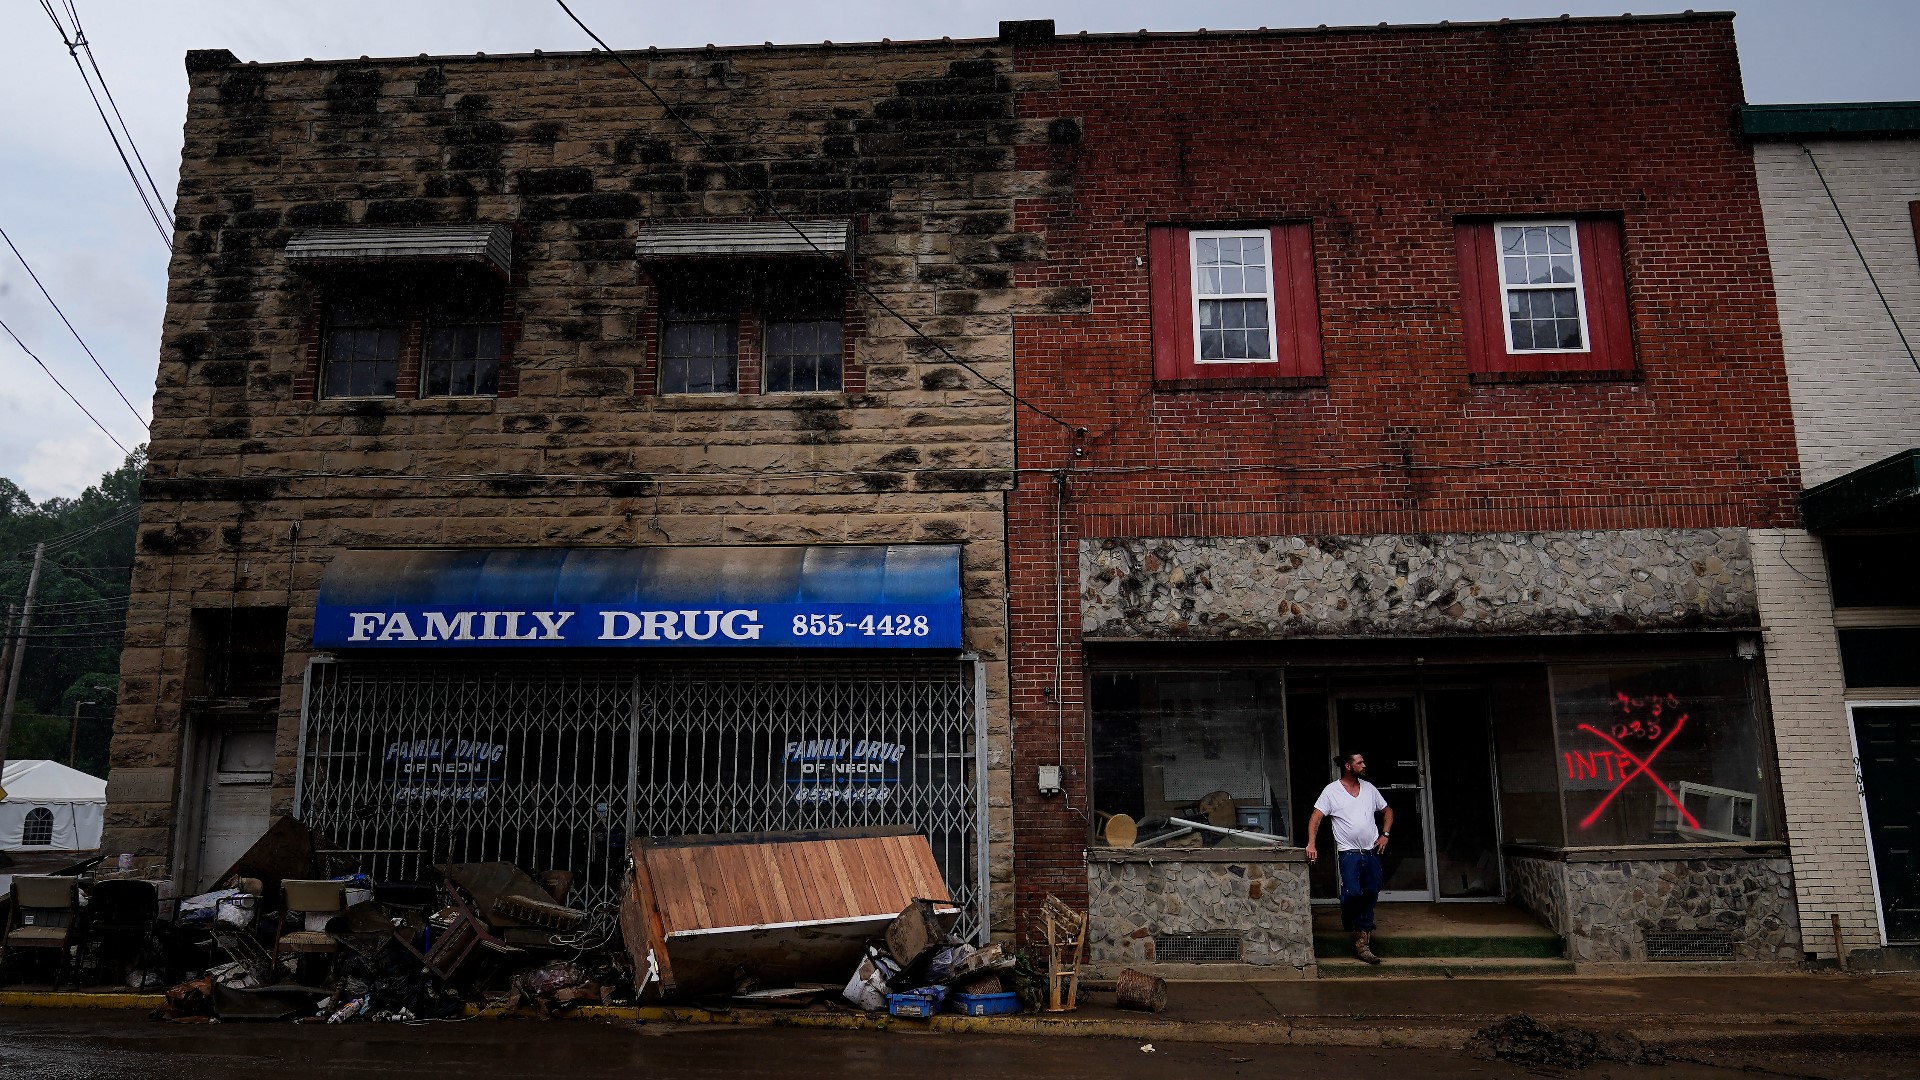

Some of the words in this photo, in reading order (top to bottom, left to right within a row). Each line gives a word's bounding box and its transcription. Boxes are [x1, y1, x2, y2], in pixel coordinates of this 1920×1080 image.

[348, 611, 575, 641] FAMILY
[598, 609, 764, 641] DRUG
[792, 613, 929, 636] 855-4428
[783, 738, 851, 763] FAMILY
[853, 739, 906, 764] DRUG
[404, 762, 427, 773] OF
[431, 762, 481, 773] NEON
[801, 763, 826, 774] OF
[831, 763, 884, 774] NEON
